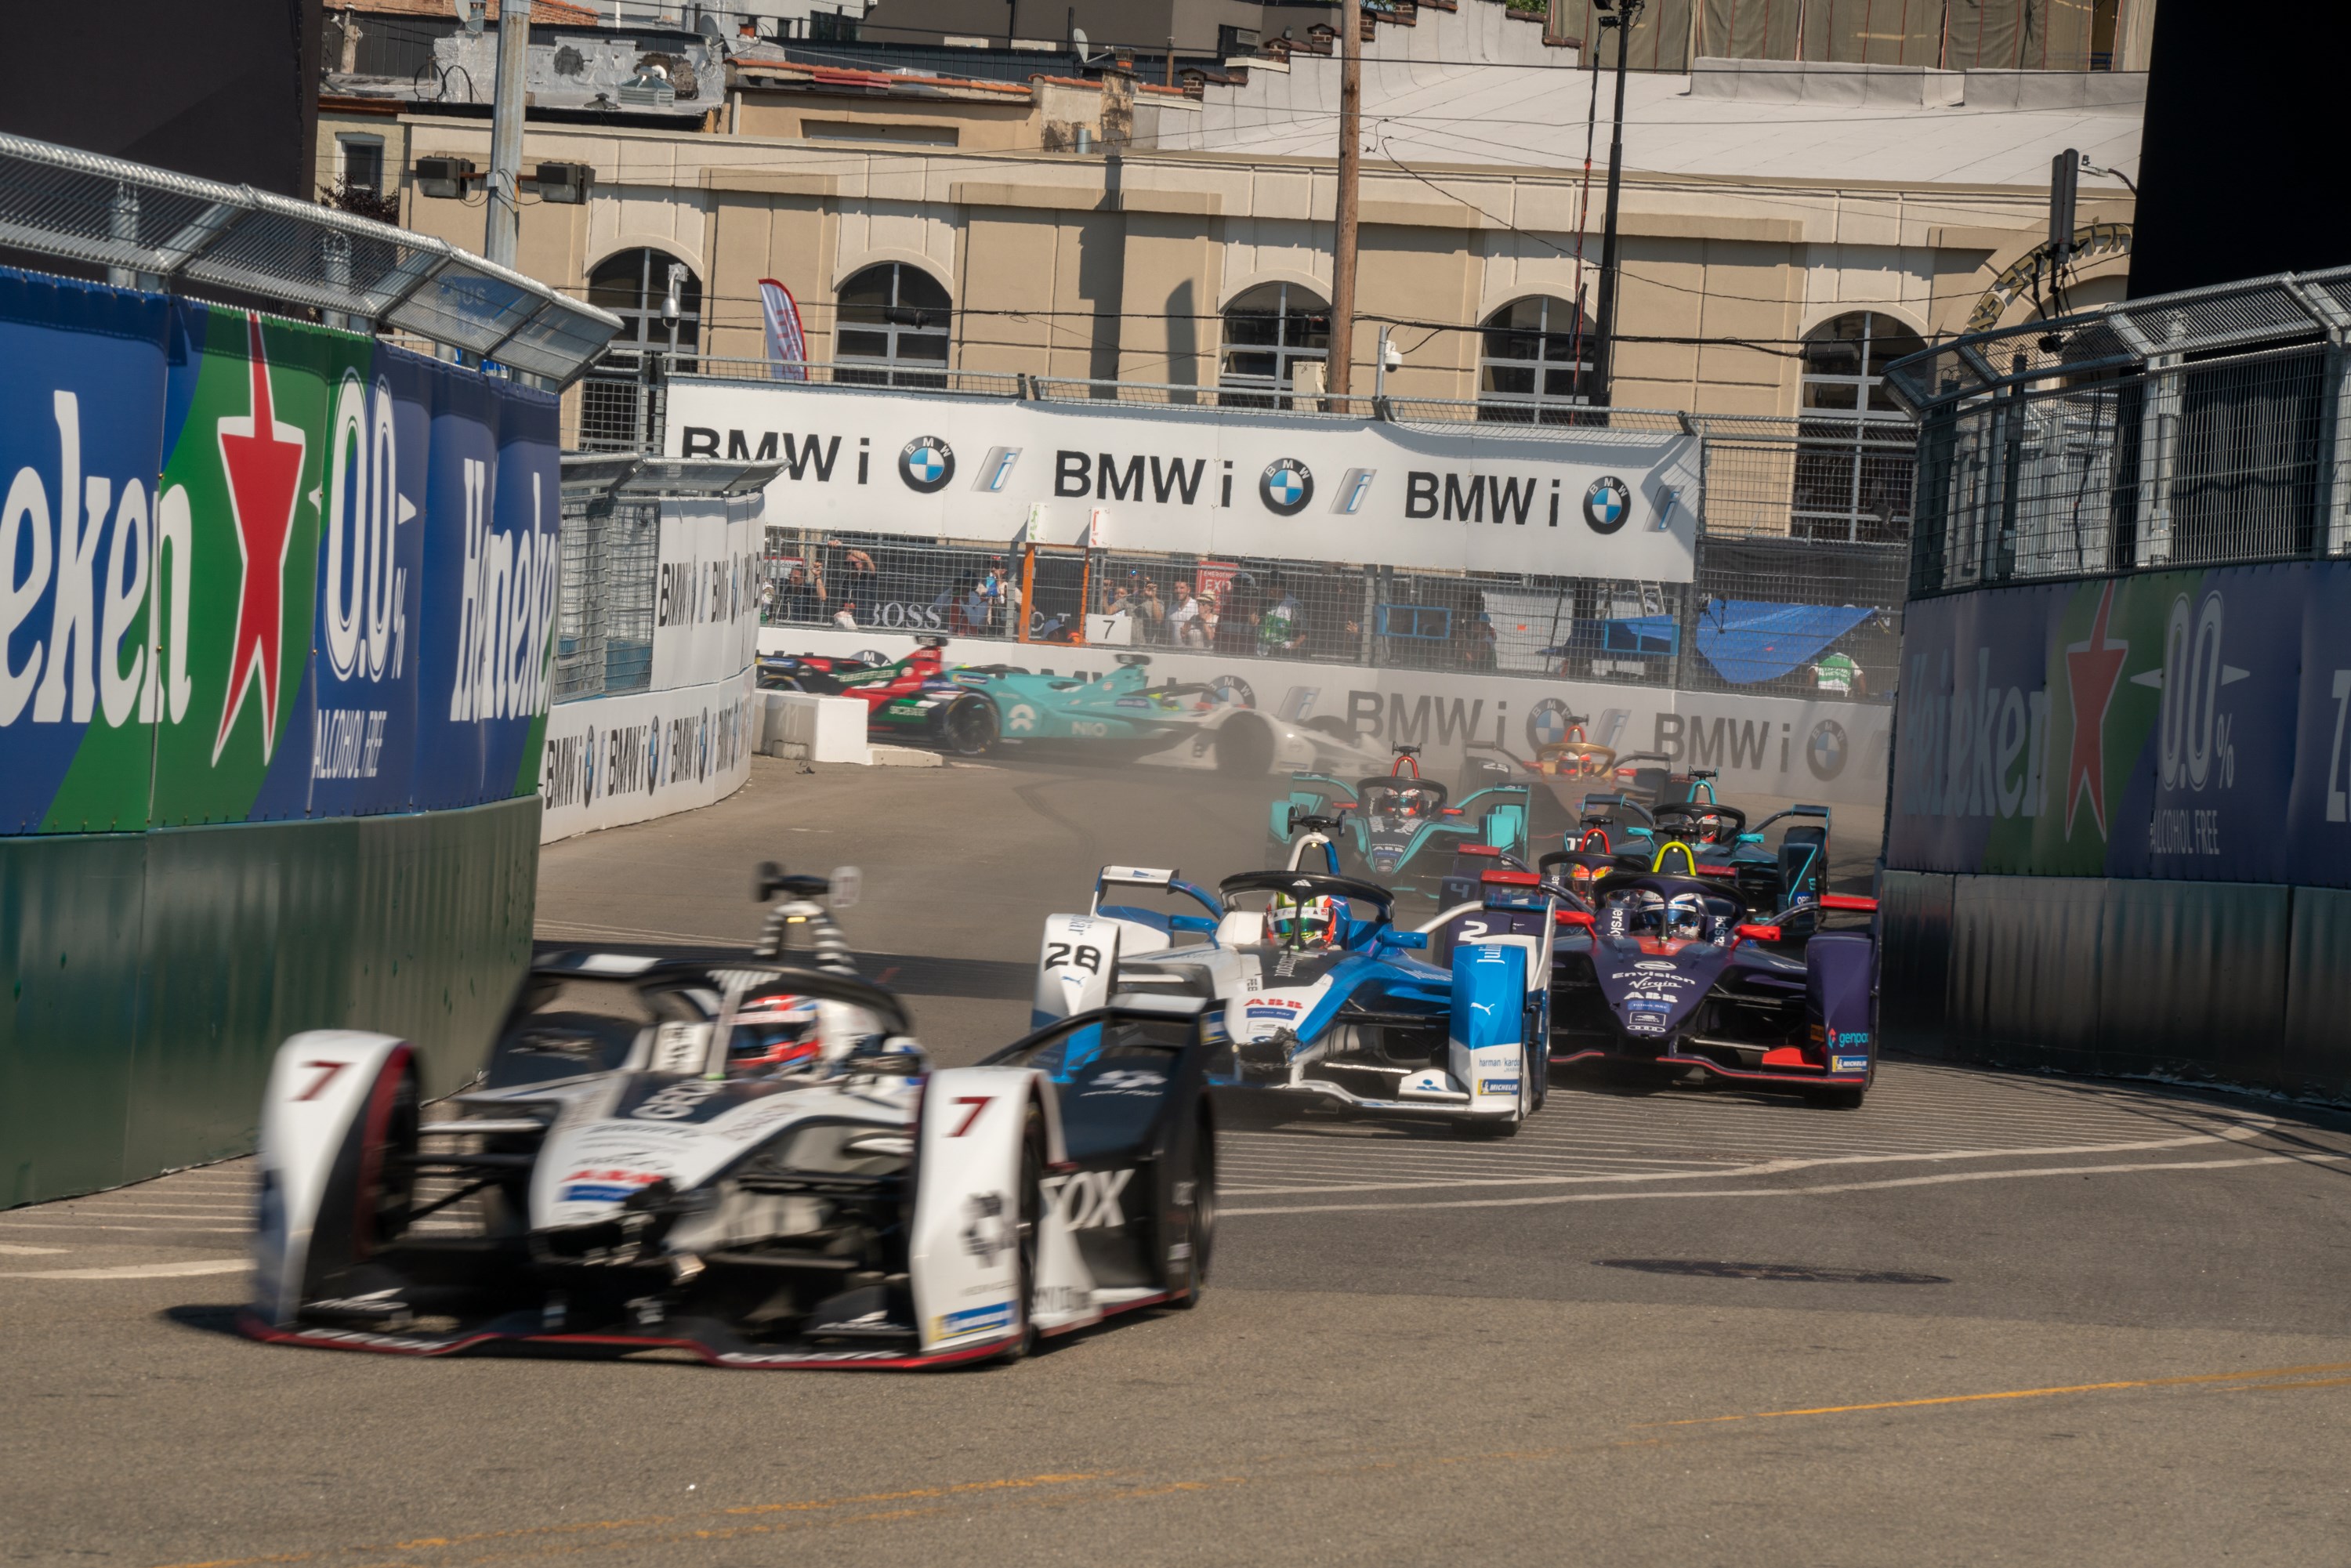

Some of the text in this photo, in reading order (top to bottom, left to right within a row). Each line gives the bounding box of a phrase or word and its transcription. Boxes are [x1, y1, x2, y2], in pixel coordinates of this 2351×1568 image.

[682, 425, 842, 482] BMW
[857, 437, 870, 484] i
[1054, 450, 1207, 505] BMW
[1221, 460, 1233, 507] i
[1405, 471, 1537, 525] BMW
[1549, 479, 1560, 527] i
[1103, 620, 1115, 639] 7
[312, 709, 387, 779] ALCOHOL FREE
[1346, 690, 1483, 745] BMW
[1654, 712, 1770, 770] BMW
[1780, 723, 1790, 773] i
[546, 736, 578, 810] BMW
[608, 726, 640, 797] BMW
[2150, 809, 2220, 855] ALCOHOL FREE
[1451, 883, 1469, 898] 4
[1458, 920, 1487, 943] 2
[1610, 908, 1625, 937] ersky
[1045, 943, 1101, 976] 28
[1477, 945, 1505, 964] Juli
[1612, 971, 1696, 985] Envision
[1629, 977, 1683, 990] Virgin
[1244, 998, 1303, 1009] ABB
[1624, 991, 1679, 1003] ABB
[299, 1059, 354, 1101] 7
[943, 1096, 998, 1138] 7
